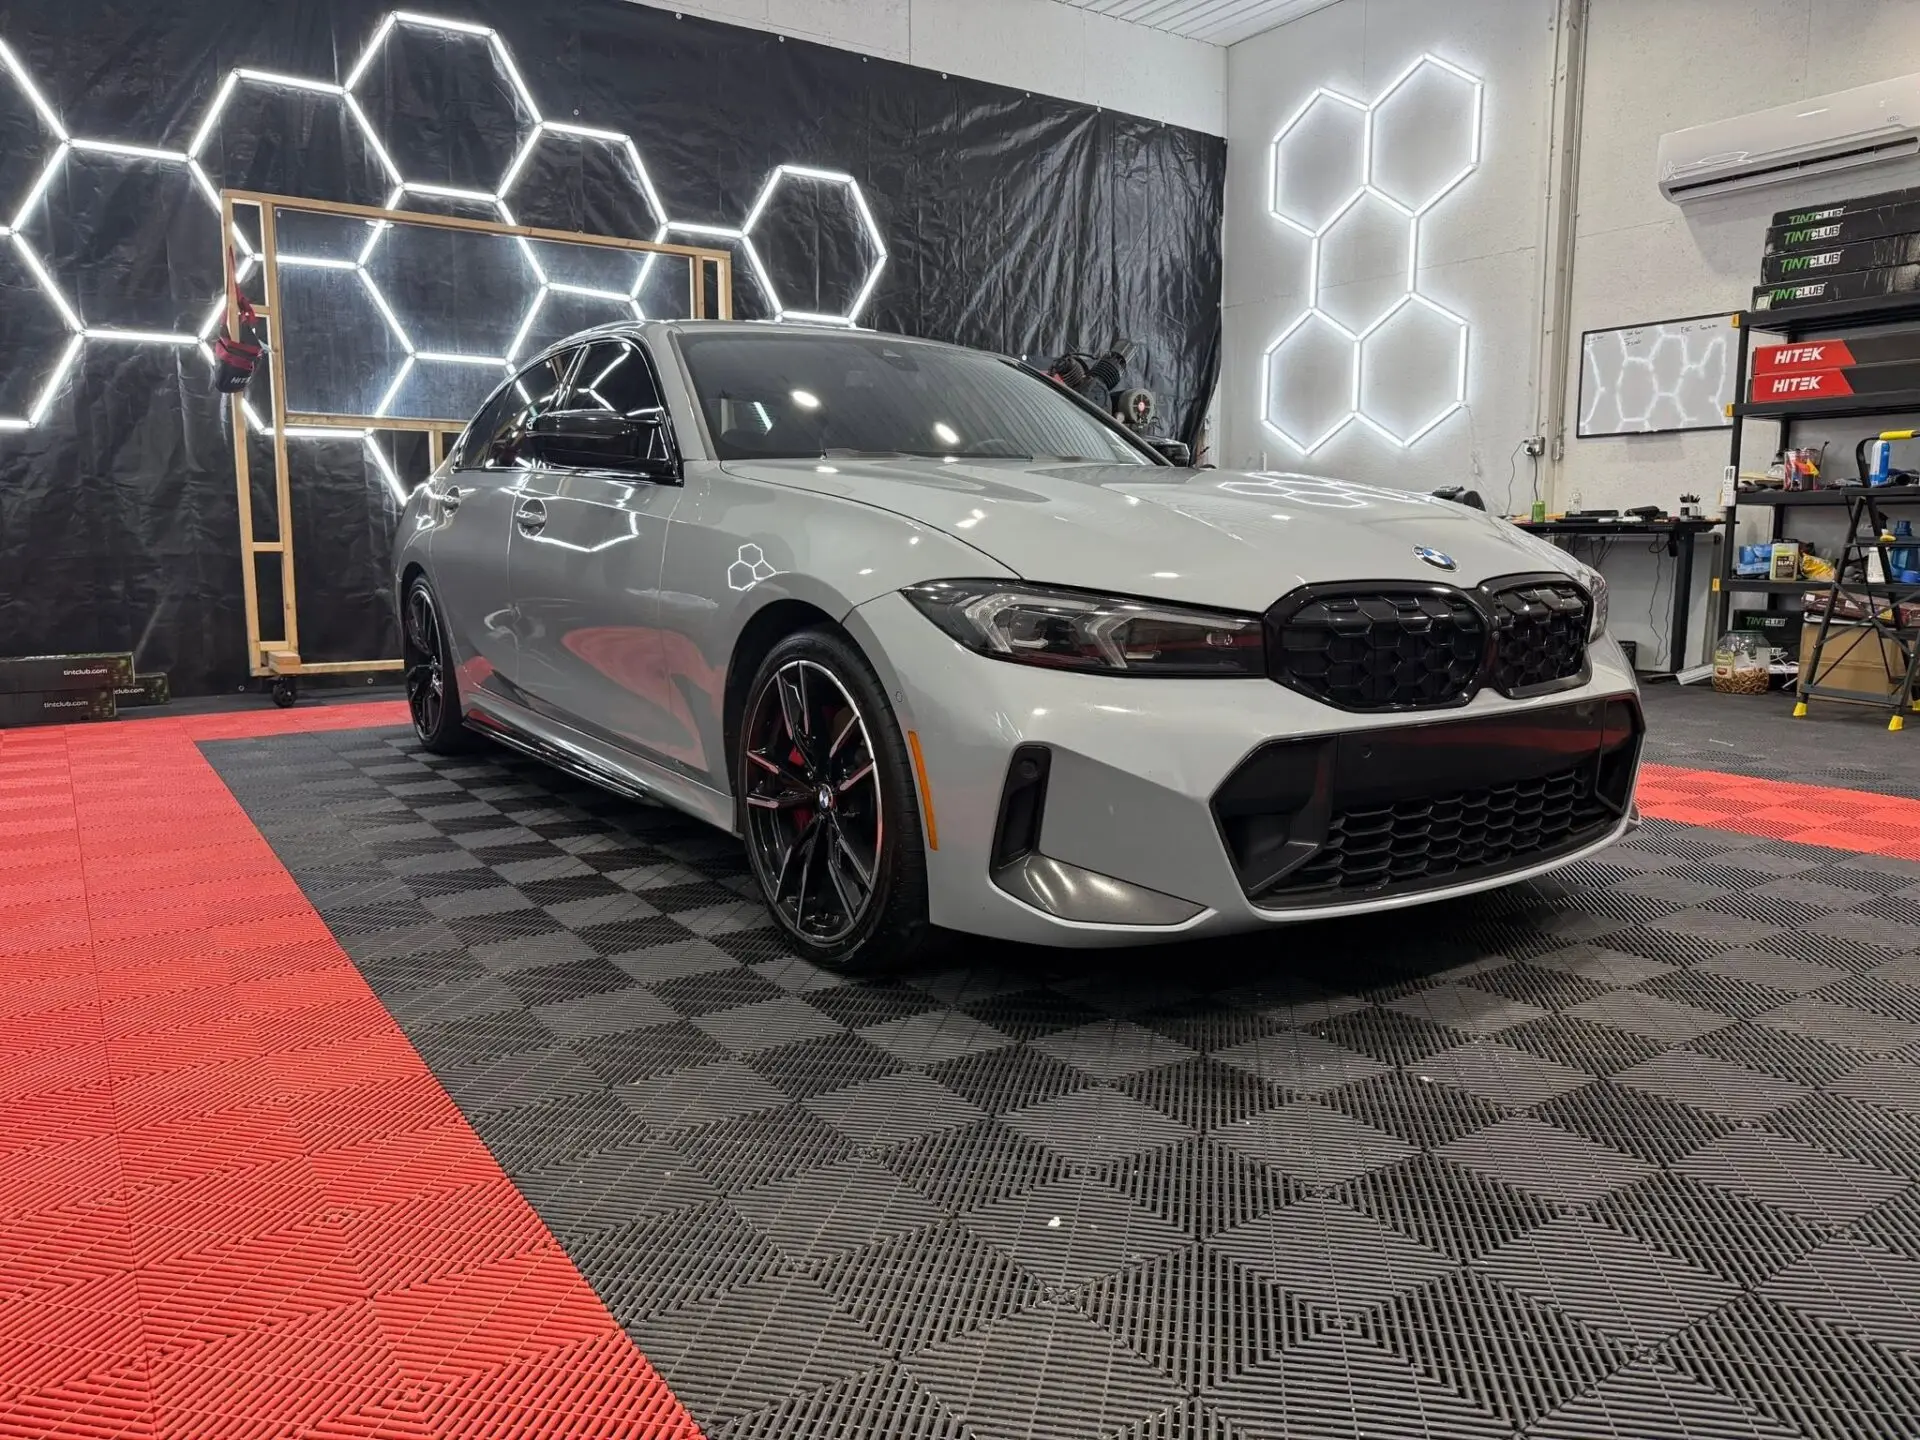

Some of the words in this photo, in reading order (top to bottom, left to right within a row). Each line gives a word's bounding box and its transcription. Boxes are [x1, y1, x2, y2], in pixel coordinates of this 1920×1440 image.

[1789, 208, 1844, 225] TINTCLUB
[1784, 225, 1841, 245] TINTCLUB
[1780, 252, 1842, 273] TINTCLUB
[1769, 284, 1825, 301] TINTCLUB
[1774, 346, 1826, 365] HITEK
[1772, 375, 1824, 393] HITEK
[63, 668, 108, 676] tintclub.com
[44, 700, 89, 708] tintclub.com
